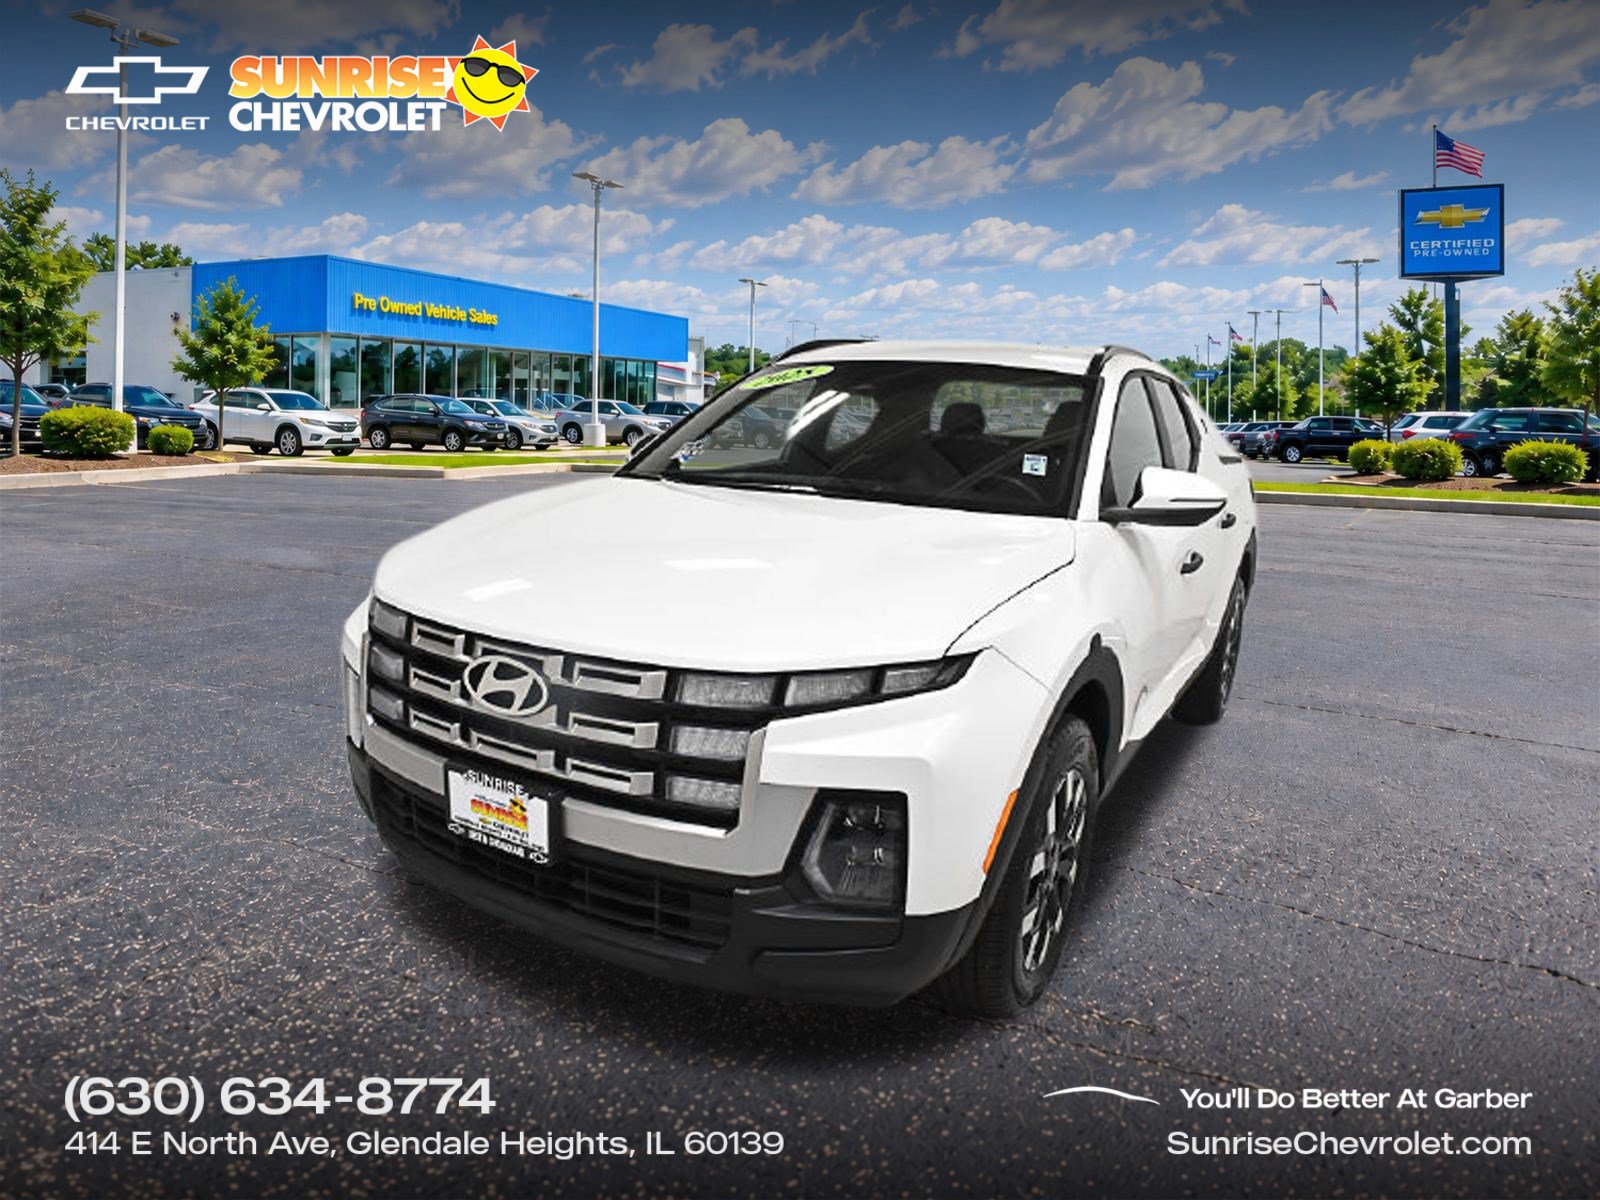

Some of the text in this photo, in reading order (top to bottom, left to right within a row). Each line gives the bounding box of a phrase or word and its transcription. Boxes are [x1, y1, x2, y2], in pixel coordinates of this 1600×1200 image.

[1410, 238, 1495, 250] CERTIFIED
[1413, 247, 1490, 257] PRE-OWNED
[353, 292, 498, 326] Pre Owned Vehicle Sales
